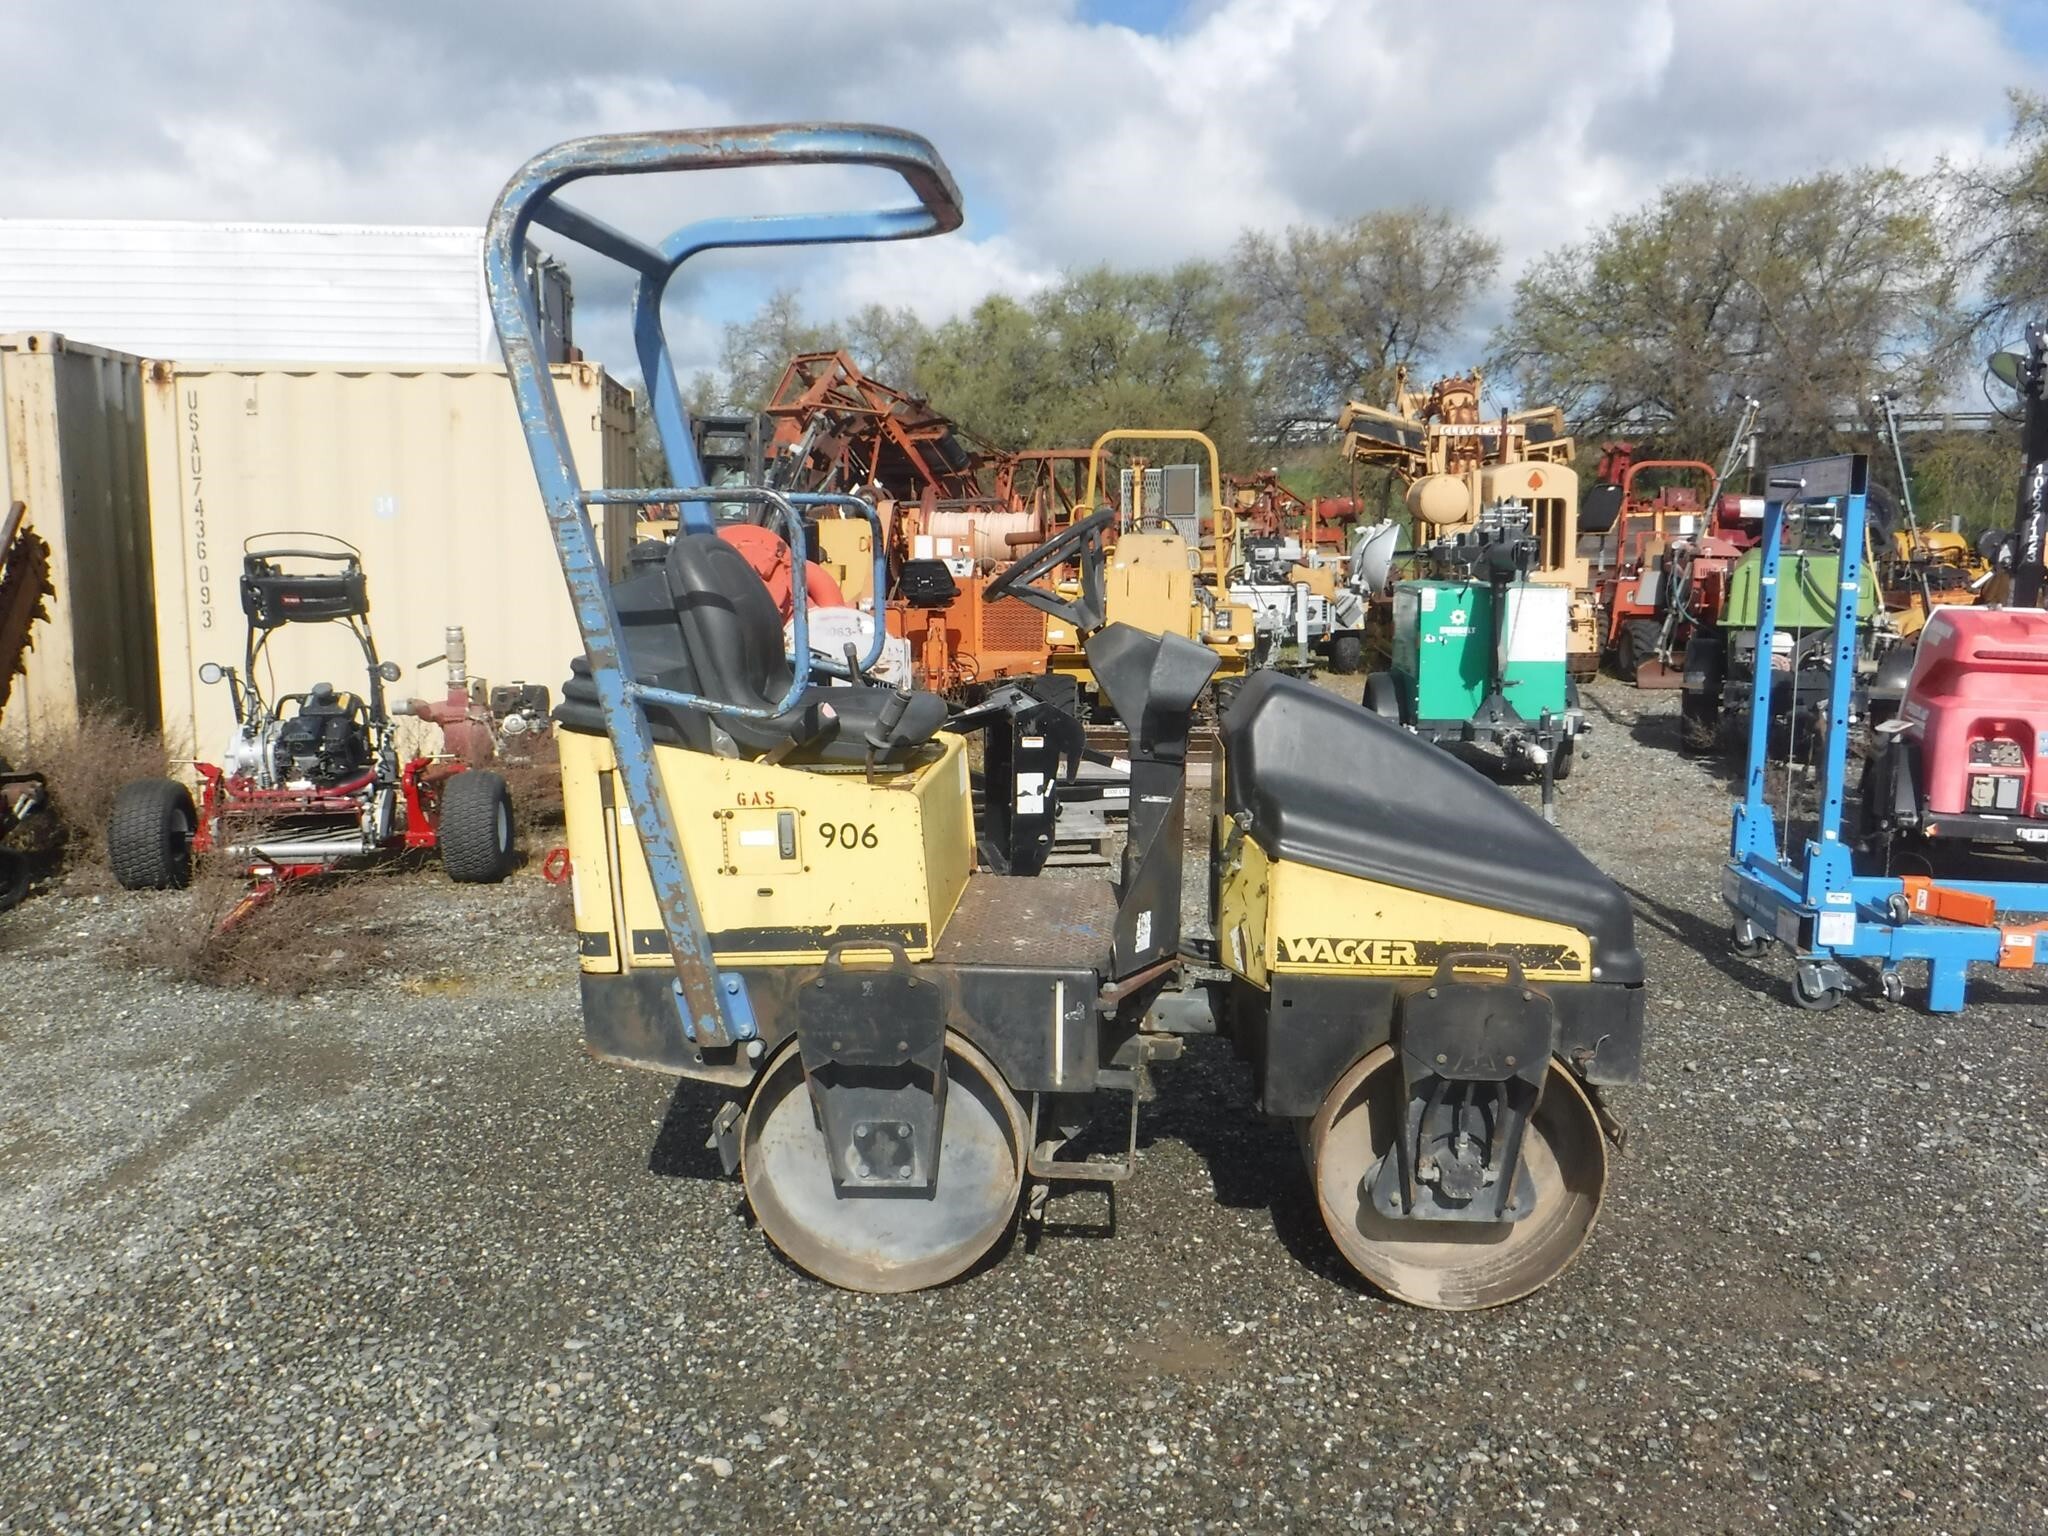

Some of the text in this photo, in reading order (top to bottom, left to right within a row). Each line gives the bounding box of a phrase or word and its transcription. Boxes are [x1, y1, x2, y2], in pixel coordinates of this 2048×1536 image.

[736, 791, 776, 807] GAS
[818, 822, 879, 850] 906
[1283, 938, 1417, 966] WACKER
